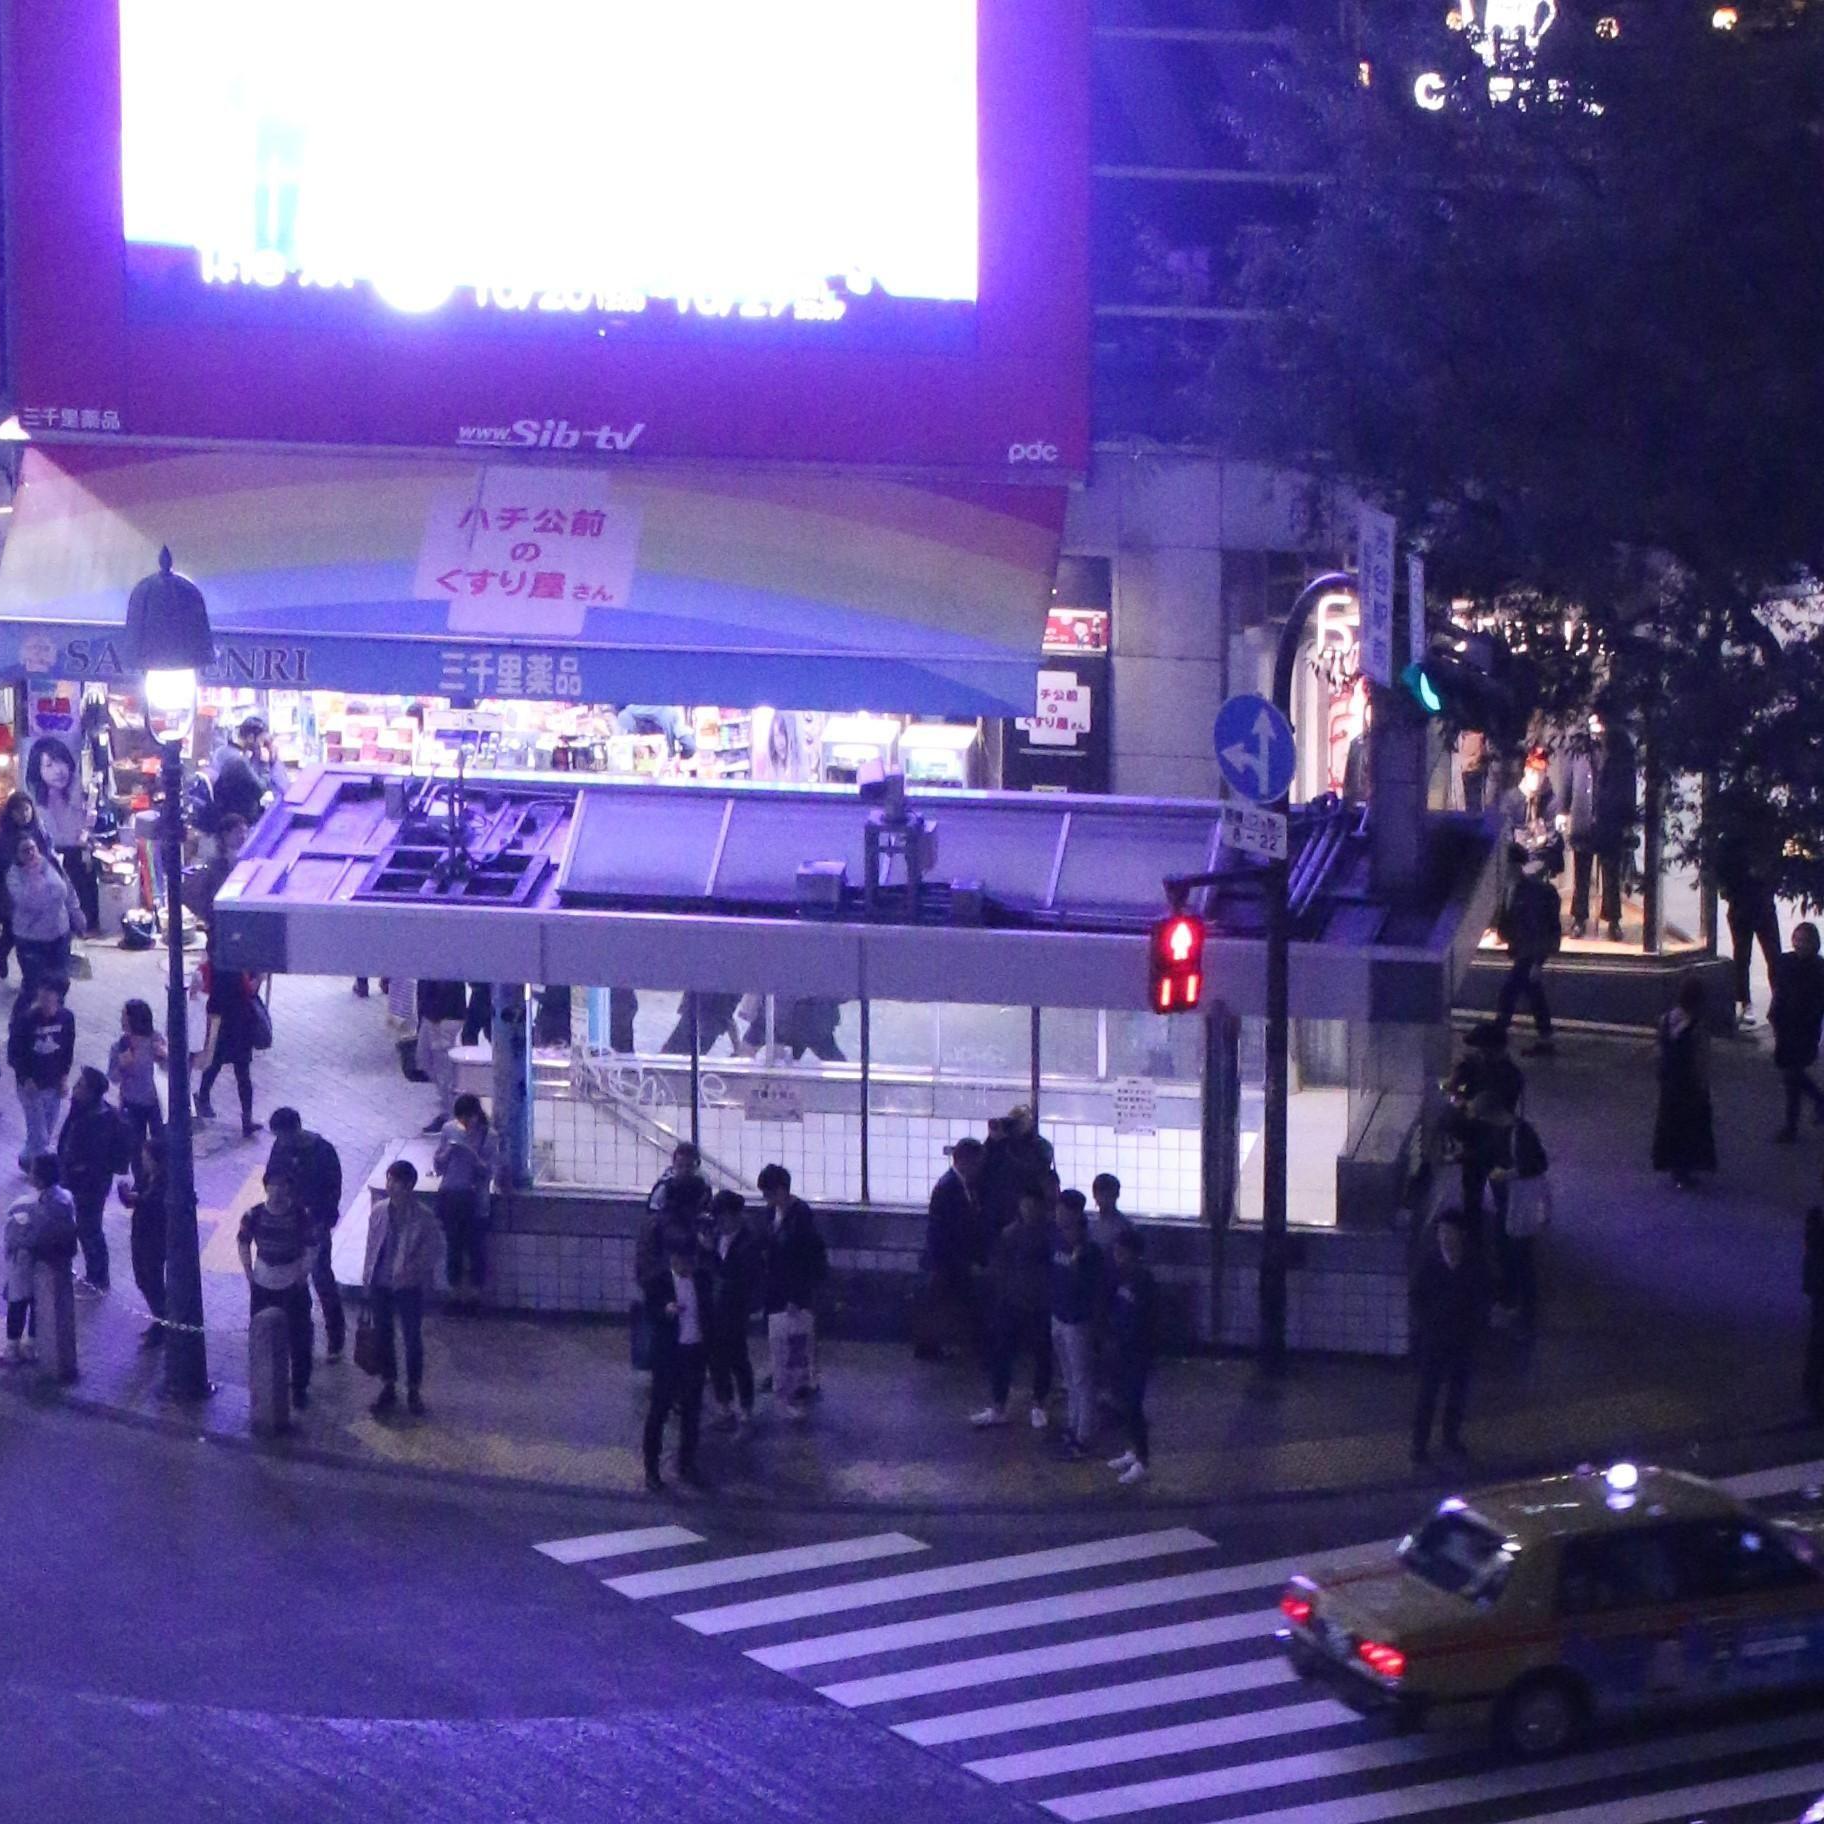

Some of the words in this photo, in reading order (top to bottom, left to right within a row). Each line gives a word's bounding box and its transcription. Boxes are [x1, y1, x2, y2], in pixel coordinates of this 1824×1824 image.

[22, 407, 121, 430] 三千里薬品
[457, 506, 607, 537] ハチ公前
[510, 542, 542, 562] の
[438, 652, 582, 696] 三千里薬品
[1040, 688, 1078, 702] チ公前
